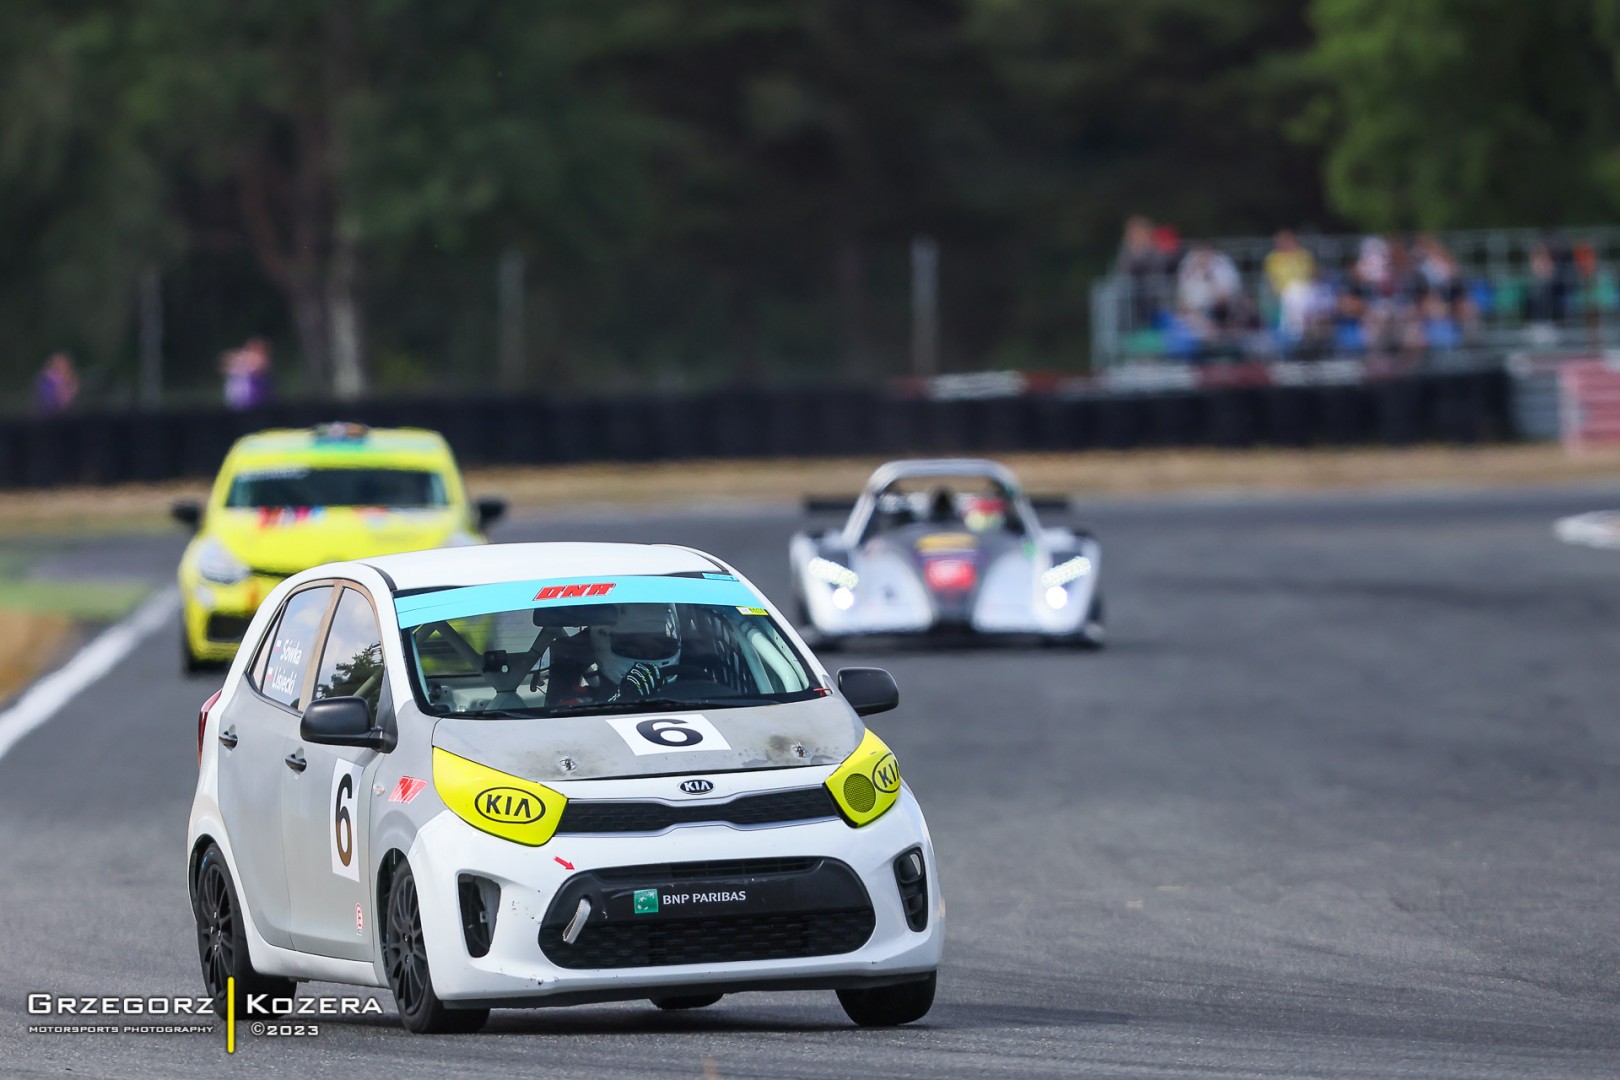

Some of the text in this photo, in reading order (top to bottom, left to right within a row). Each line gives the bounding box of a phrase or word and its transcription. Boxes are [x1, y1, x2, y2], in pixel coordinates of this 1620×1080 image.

[272, 667, 297, 695] Lisiecki
[636, 719, 703, 746] 6
[683, 780, 711, 792] KIA
[486, 794, 531, 819] KIA
[335, 773, 353, 867] 6
[663, 890, 747, 905] BNP PARIBAS
